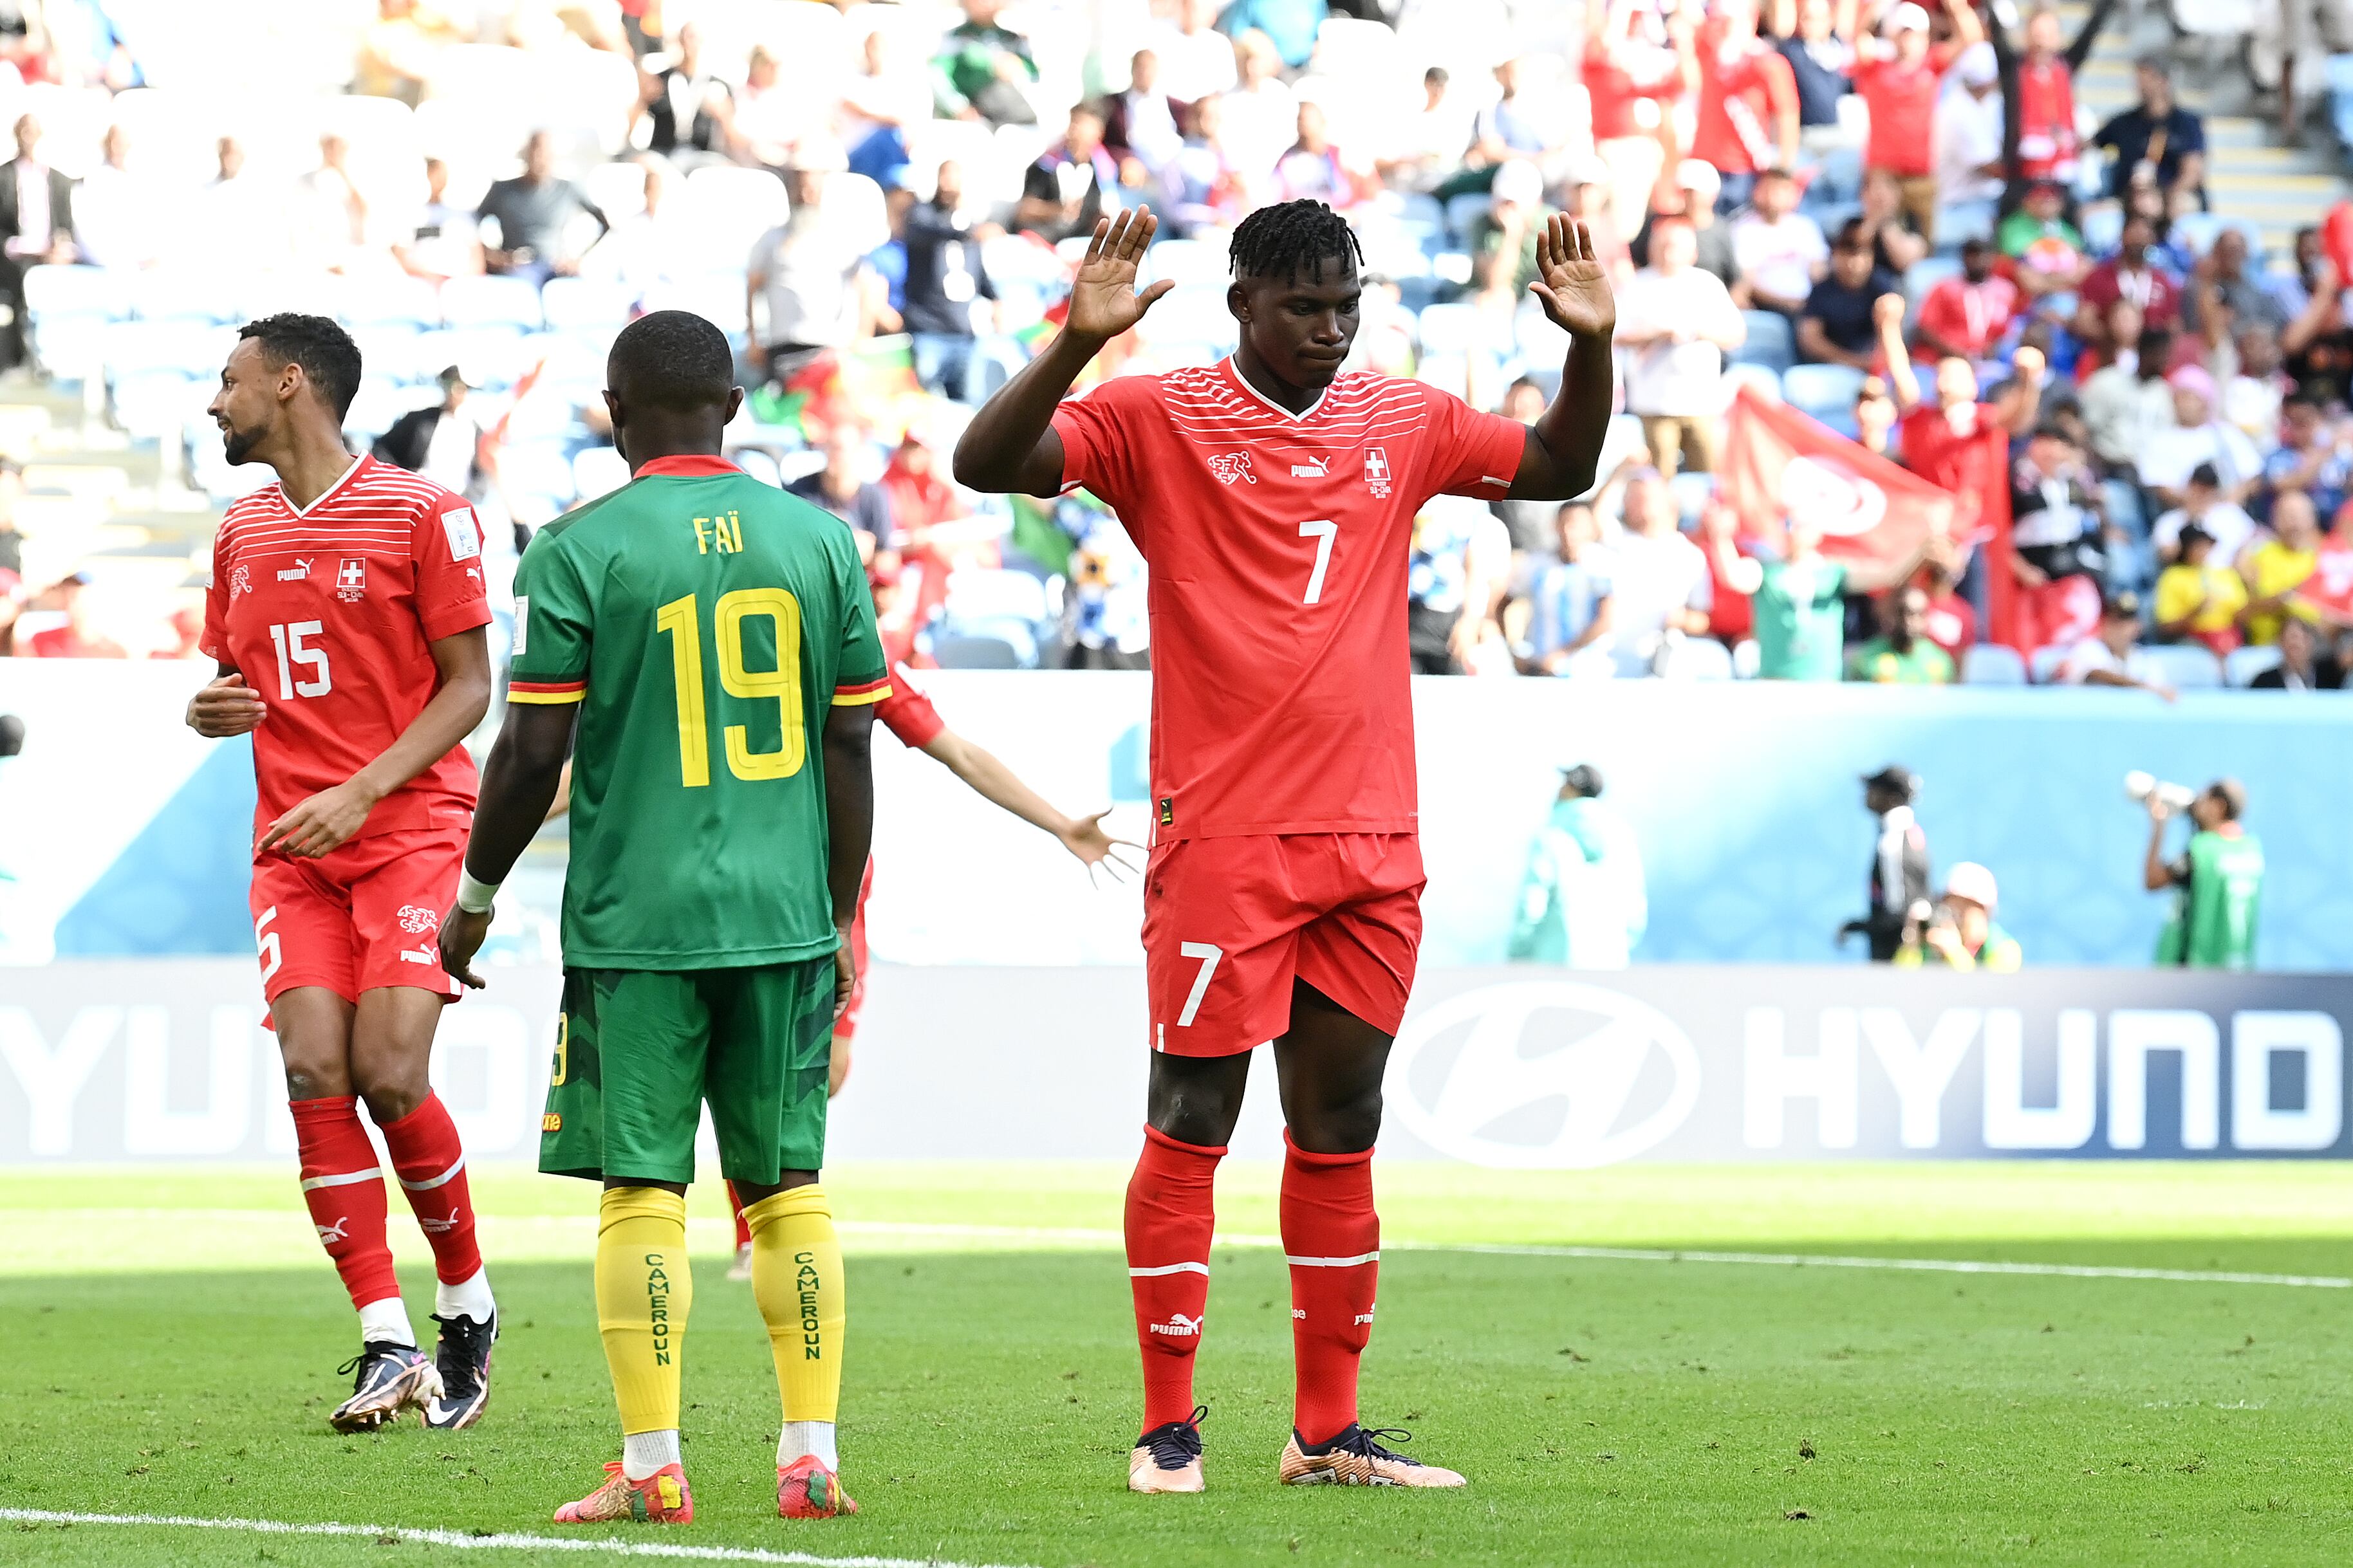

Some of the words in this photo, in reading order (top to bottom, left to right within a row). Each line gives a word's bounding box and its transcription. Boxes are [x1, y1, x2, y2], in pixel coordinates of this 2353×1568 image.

[1291, 465, 1325, 477] PUMA
[693, 510, 743, 555] FAÏ
[1298, 520, 1338, 604] 7
[277, 568, 306, 582] PUMA
[269, 620, 331, 699] 15
[656, 587, 805, 787] 19
[1176, 941, 1223, 1027] 7
[646, 1254, 671, 1366] CAMEROUN
[794, 1252, 821, 1360] CAMEROUN
[1150, 1323, 1193, 1336] puma
